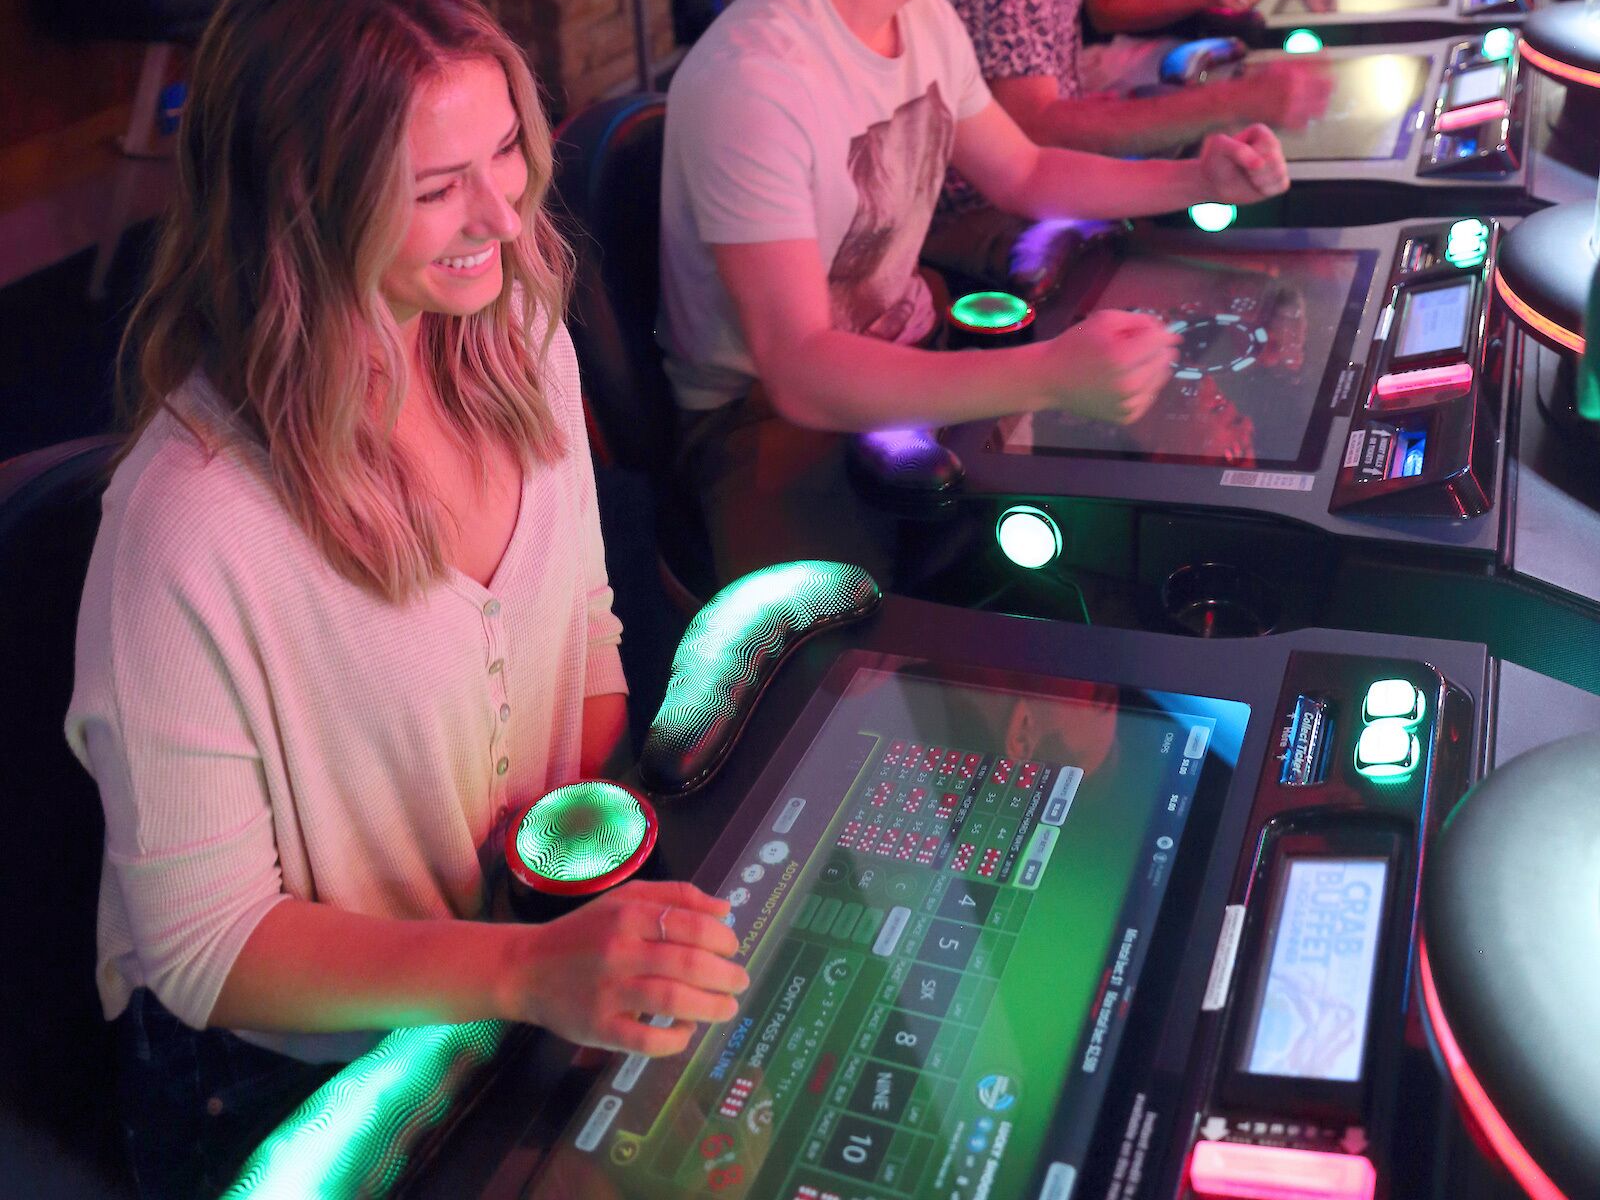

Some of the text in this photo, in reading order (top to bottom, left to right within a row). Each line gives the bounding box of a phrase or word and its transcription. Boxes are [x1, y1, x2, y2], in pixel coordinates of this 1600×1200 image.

[1160, 732, 1174, 754] CRAPS
[1280, 727, 1292, 747] Here
[1293, 712, 1314, 773] Collect Ticket
[1178, 758, 1190, 775] $0.00
[955, 795, 973, 822] HOP BETS
[1167, 794, 1179, 812] $0.00
[1011, 791, 1042, 851] HOPPING HARD WAYS
[858, 870, 874, 888] C&E
[738, 860, 799, 956] ADD FUNDS TO PLAY
[958, 894, 976, 905] 4
[1300, 870, 1345, 968] BUFFET
[1334, 880, 1372, 955] CRAB
[938, 937, 959, 949] 5
[1124, 928, 1138, 942] Min
[1118, 942, 1134, 960] total
[833, 968, 847, 976] 2
[1114, 960, 1129, 975] bet:
[920, 979, 936, 1000] SIX
[1109, 975, 1123, 986] $1
[821, 998, 834, 1006] 3
[1102, 990, 1118, 1008] Max
[747, 976, 805, 1067] DON'T PASS BAR
[815, 1018, 826, 1026] 4
[1097, 1007, 1112, 1028] total
[786, 1027, 805, 1050] FIELD
[805, 1038, 817, 1047] 9
[895, 1031, 917, 1047] 8
[1091, 1027, 1105, 1044] bet:
[708, 1018, 753, 1079] PASS LINE
[791, 1059, 805, 1070] 10
[778, 1079, 791, 1091] 11
[872, 1072, 893, 1109] NINE
[842, 1134, 872, 1163] 10
[991, 1121, 1012, 1159] LUCKY
